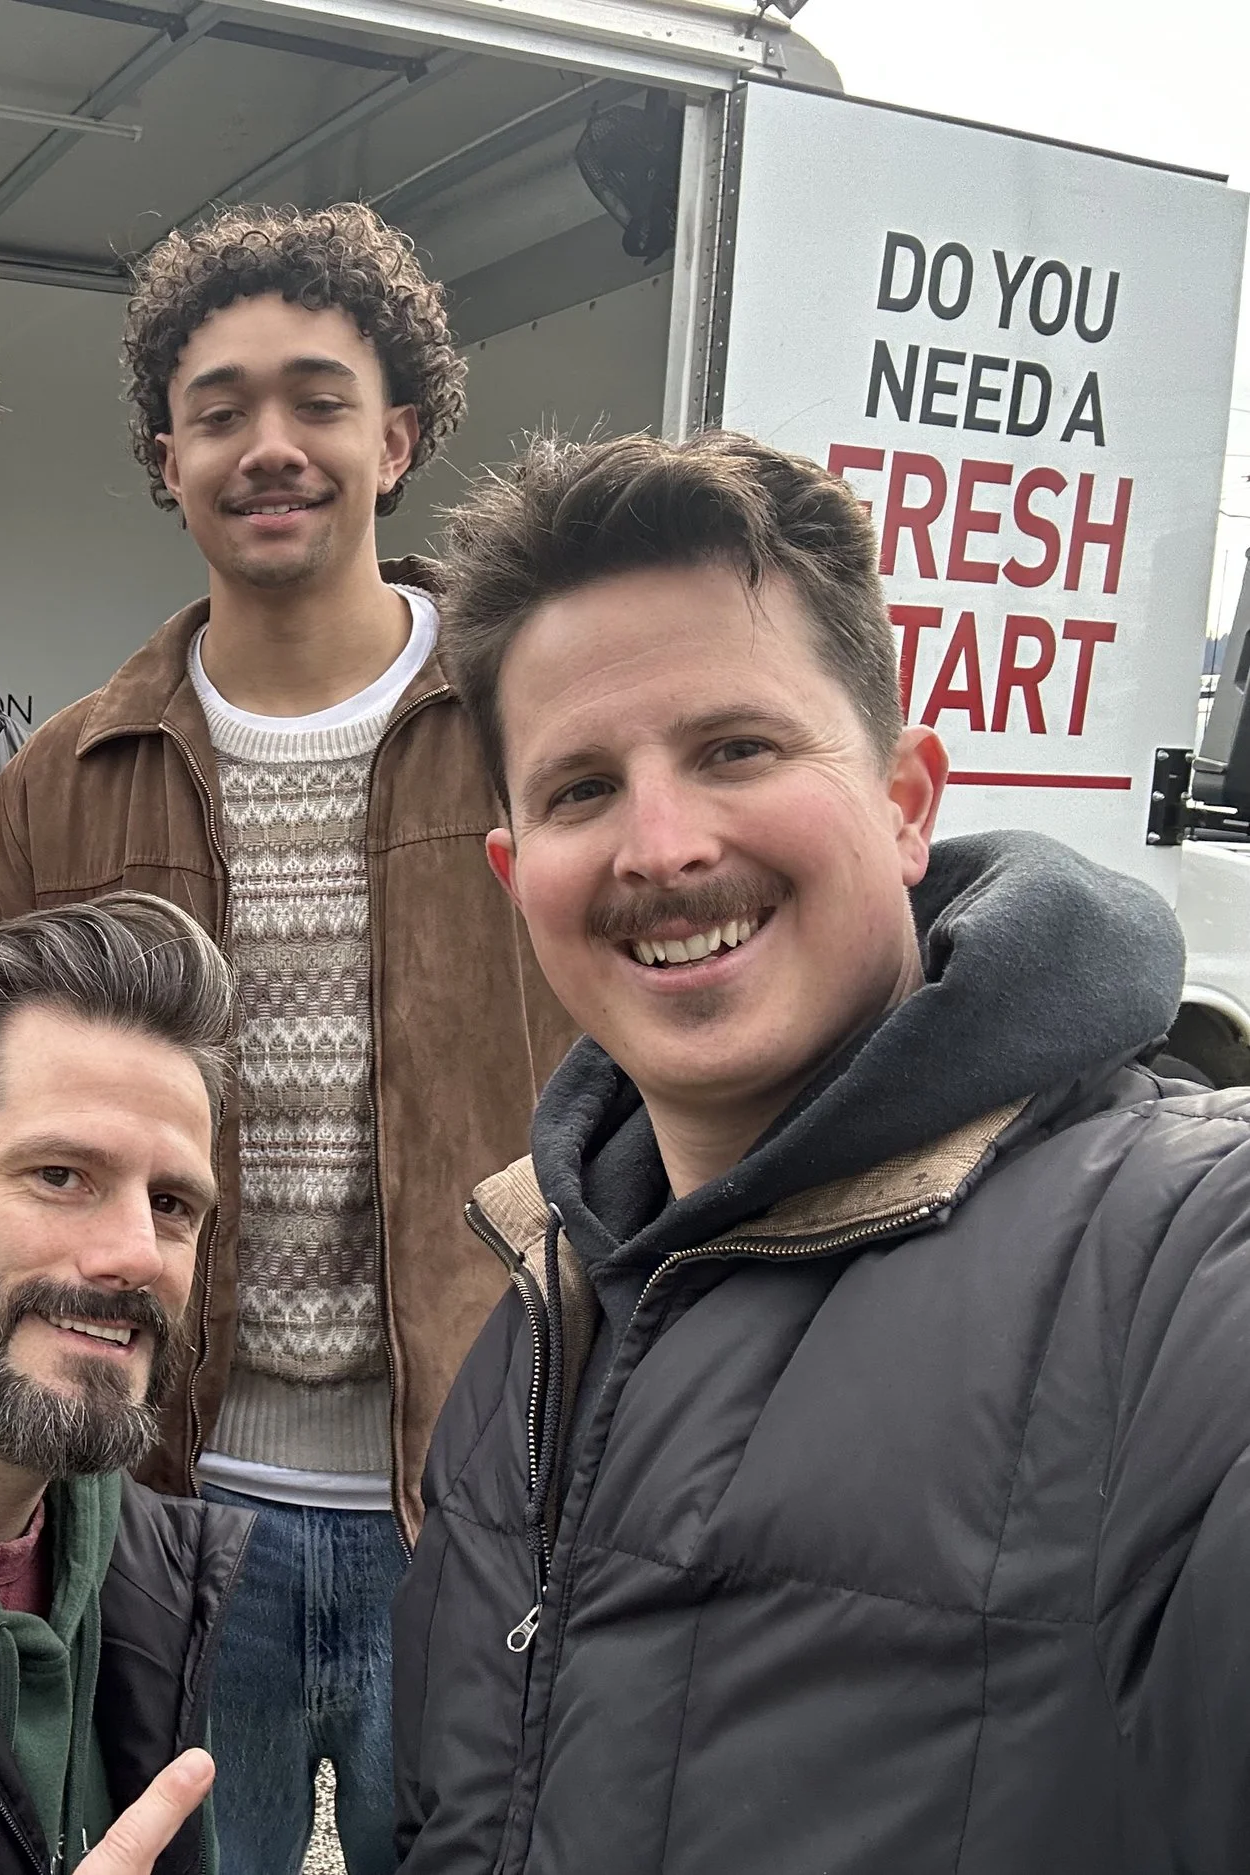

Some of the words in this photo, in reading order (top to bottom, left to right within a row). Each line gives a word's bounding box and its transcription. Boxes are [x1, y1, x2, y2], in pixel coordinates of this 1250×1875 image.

[877, 230, 974, 321] DO
[992, 249, 1120, 343] YOU
[865, 339, 1052, 437] NEED
[1059, 370, 1105, 446] A
